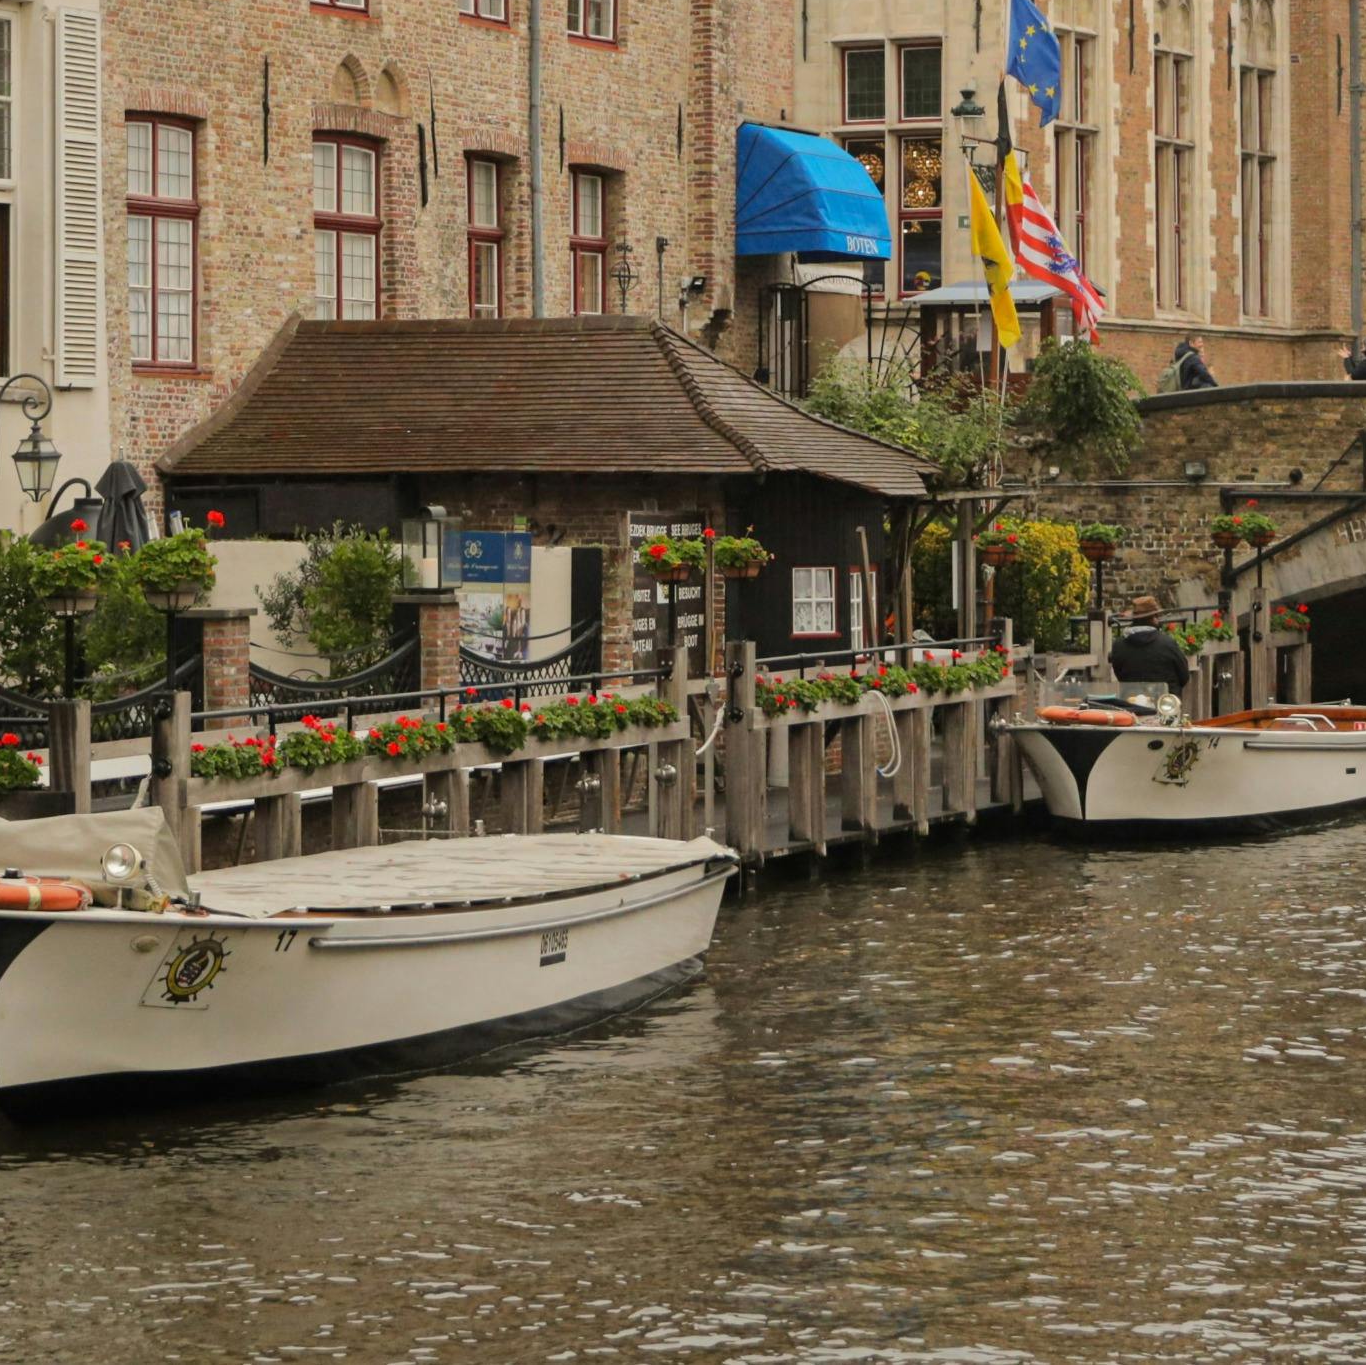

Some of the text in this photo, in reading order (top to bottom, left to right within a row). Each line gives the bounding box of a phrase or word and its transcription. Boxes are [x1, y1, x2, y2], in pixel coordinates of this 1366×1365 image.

[846, 236, 879, 254] BOTEN
[671, 523, 702, 536] SEE BRUGES
[678, 586, 701, 600] BESUCHT
[635, 617, 656, 631] UGES EN
[275, 929, 299, 952] 17
